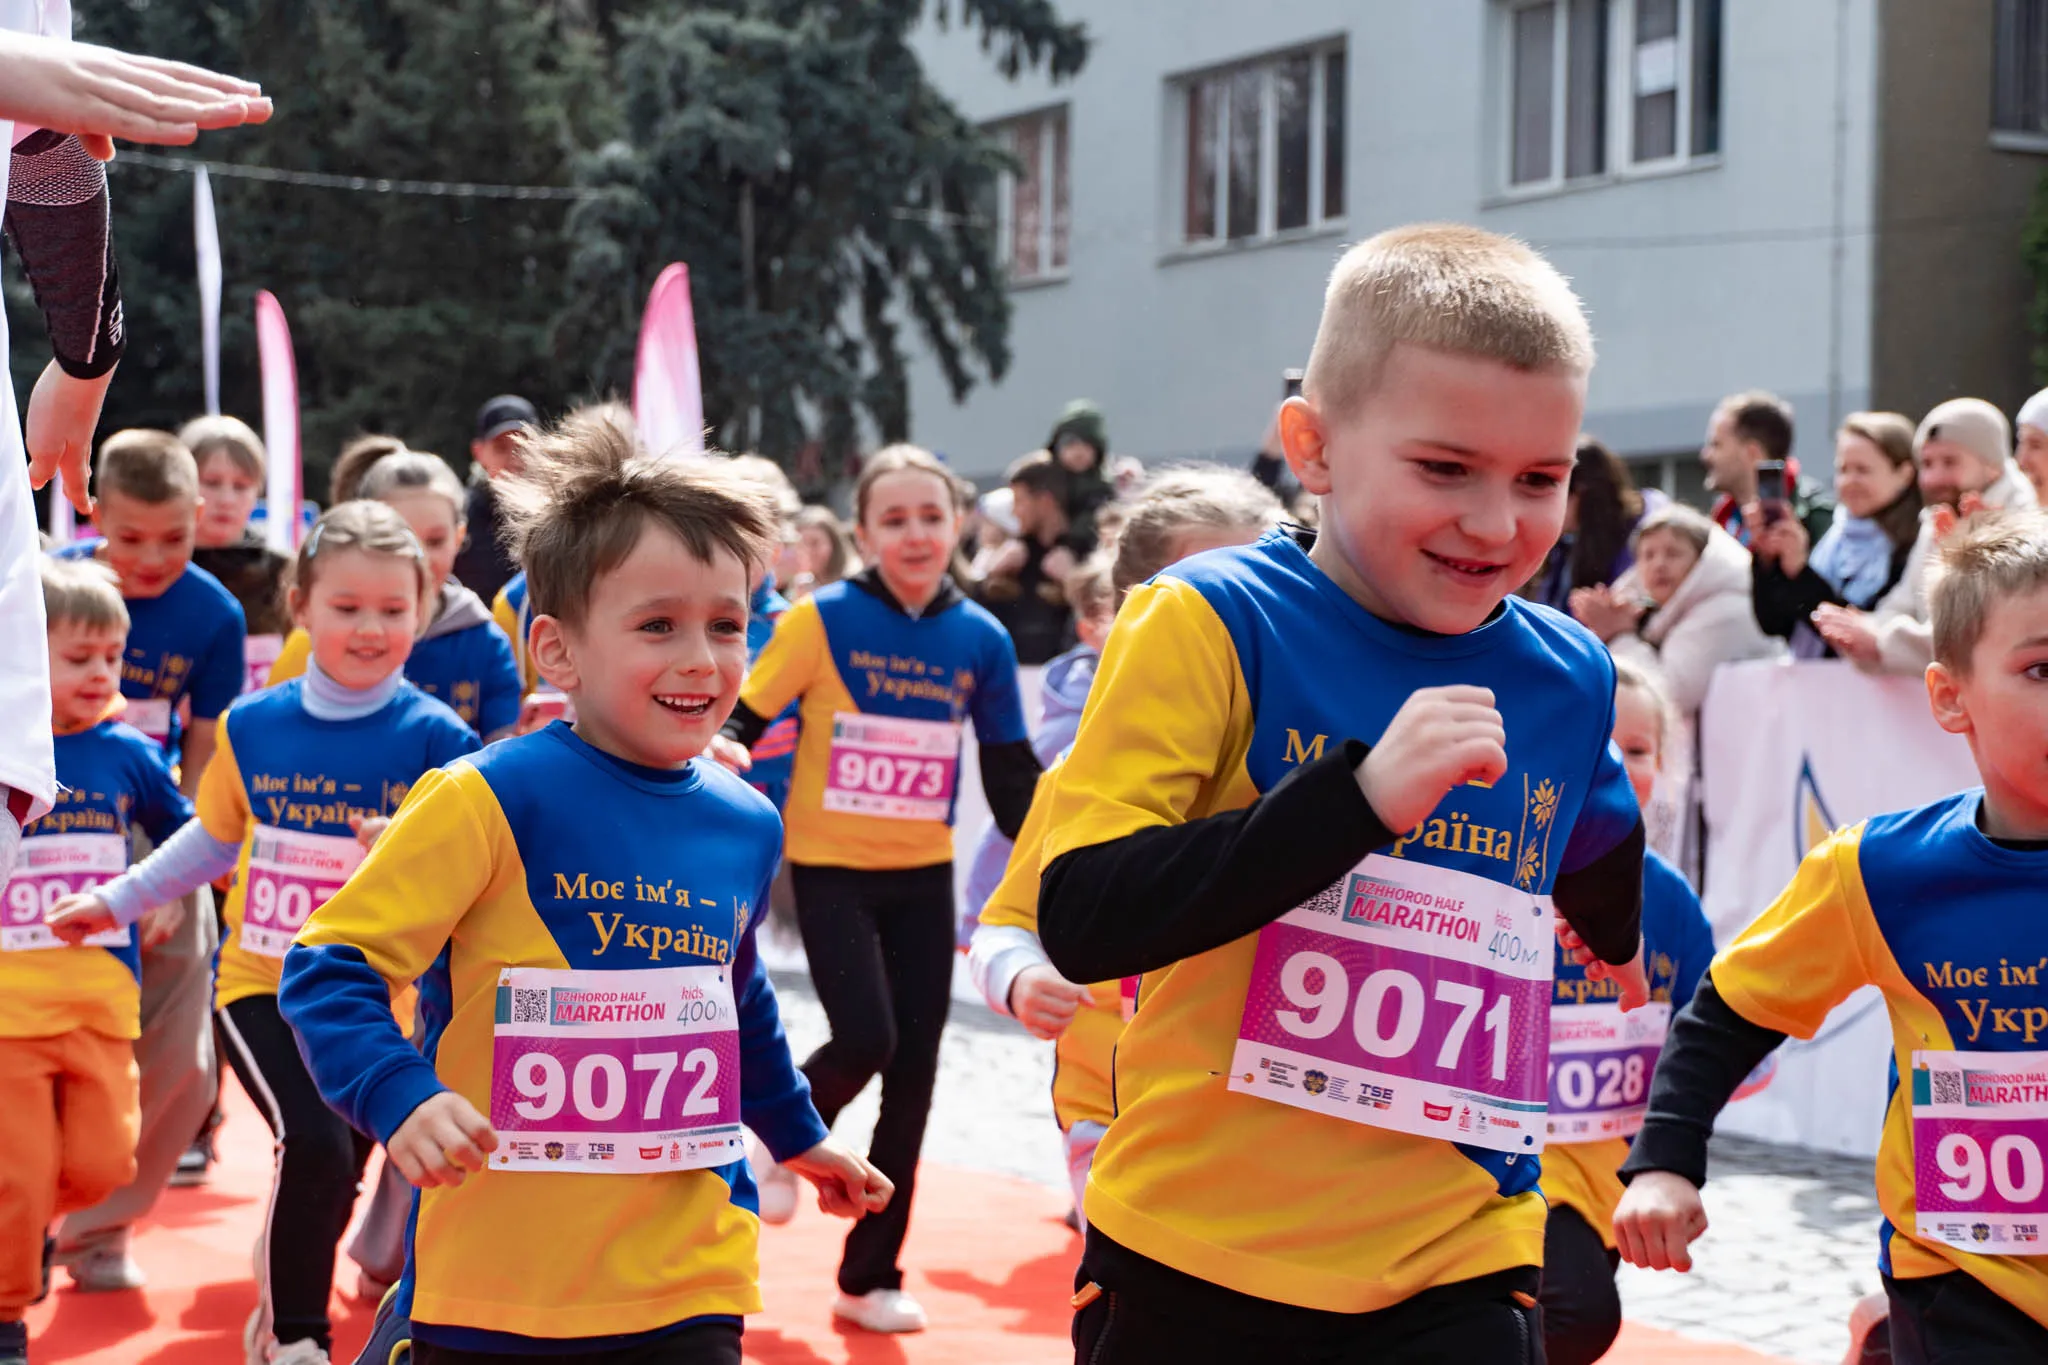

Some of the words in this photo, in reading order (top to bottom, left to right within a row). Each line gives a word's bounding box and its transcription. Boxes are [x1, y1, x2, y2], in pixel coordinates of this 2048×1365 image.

[252, 774, 289, 793] Моє
[837, 753, 944, 797] 9073
[1389, 811, 1513, 861] раїна
[253, 877, 339, 927] 90
[553, 873, 624, 899] Моє
[635, 875, 691, 908] ім'я
[1355, 880, 1433, 907] UZHHOROD
[1434, 896, 1465, 913] HALF
[1349, 896, 1481, 943] MARATHON
[1495, 908, 1513, 931] kids
[587, 912, 729, 962] Україна
[1923, 961, 1989, 988] Моє
[555, 991, 618, 1002] UZHHOROD
[620, 991, 647, 1002] HALF
[681, 985, 704, 1000] kids
[555, 1002, 666, 1022] MARATHON
[1276, 951, 1512, 1081] 9071
[512, 1047, 720, 1121] 9072
[1360, 1082, 1394, 1100] TSE
[1548, 1054, 1644, 1109] 028
[1968, 1085, 2048, 1103] MARATH
[589, 1143, 615, 1153] TSE
